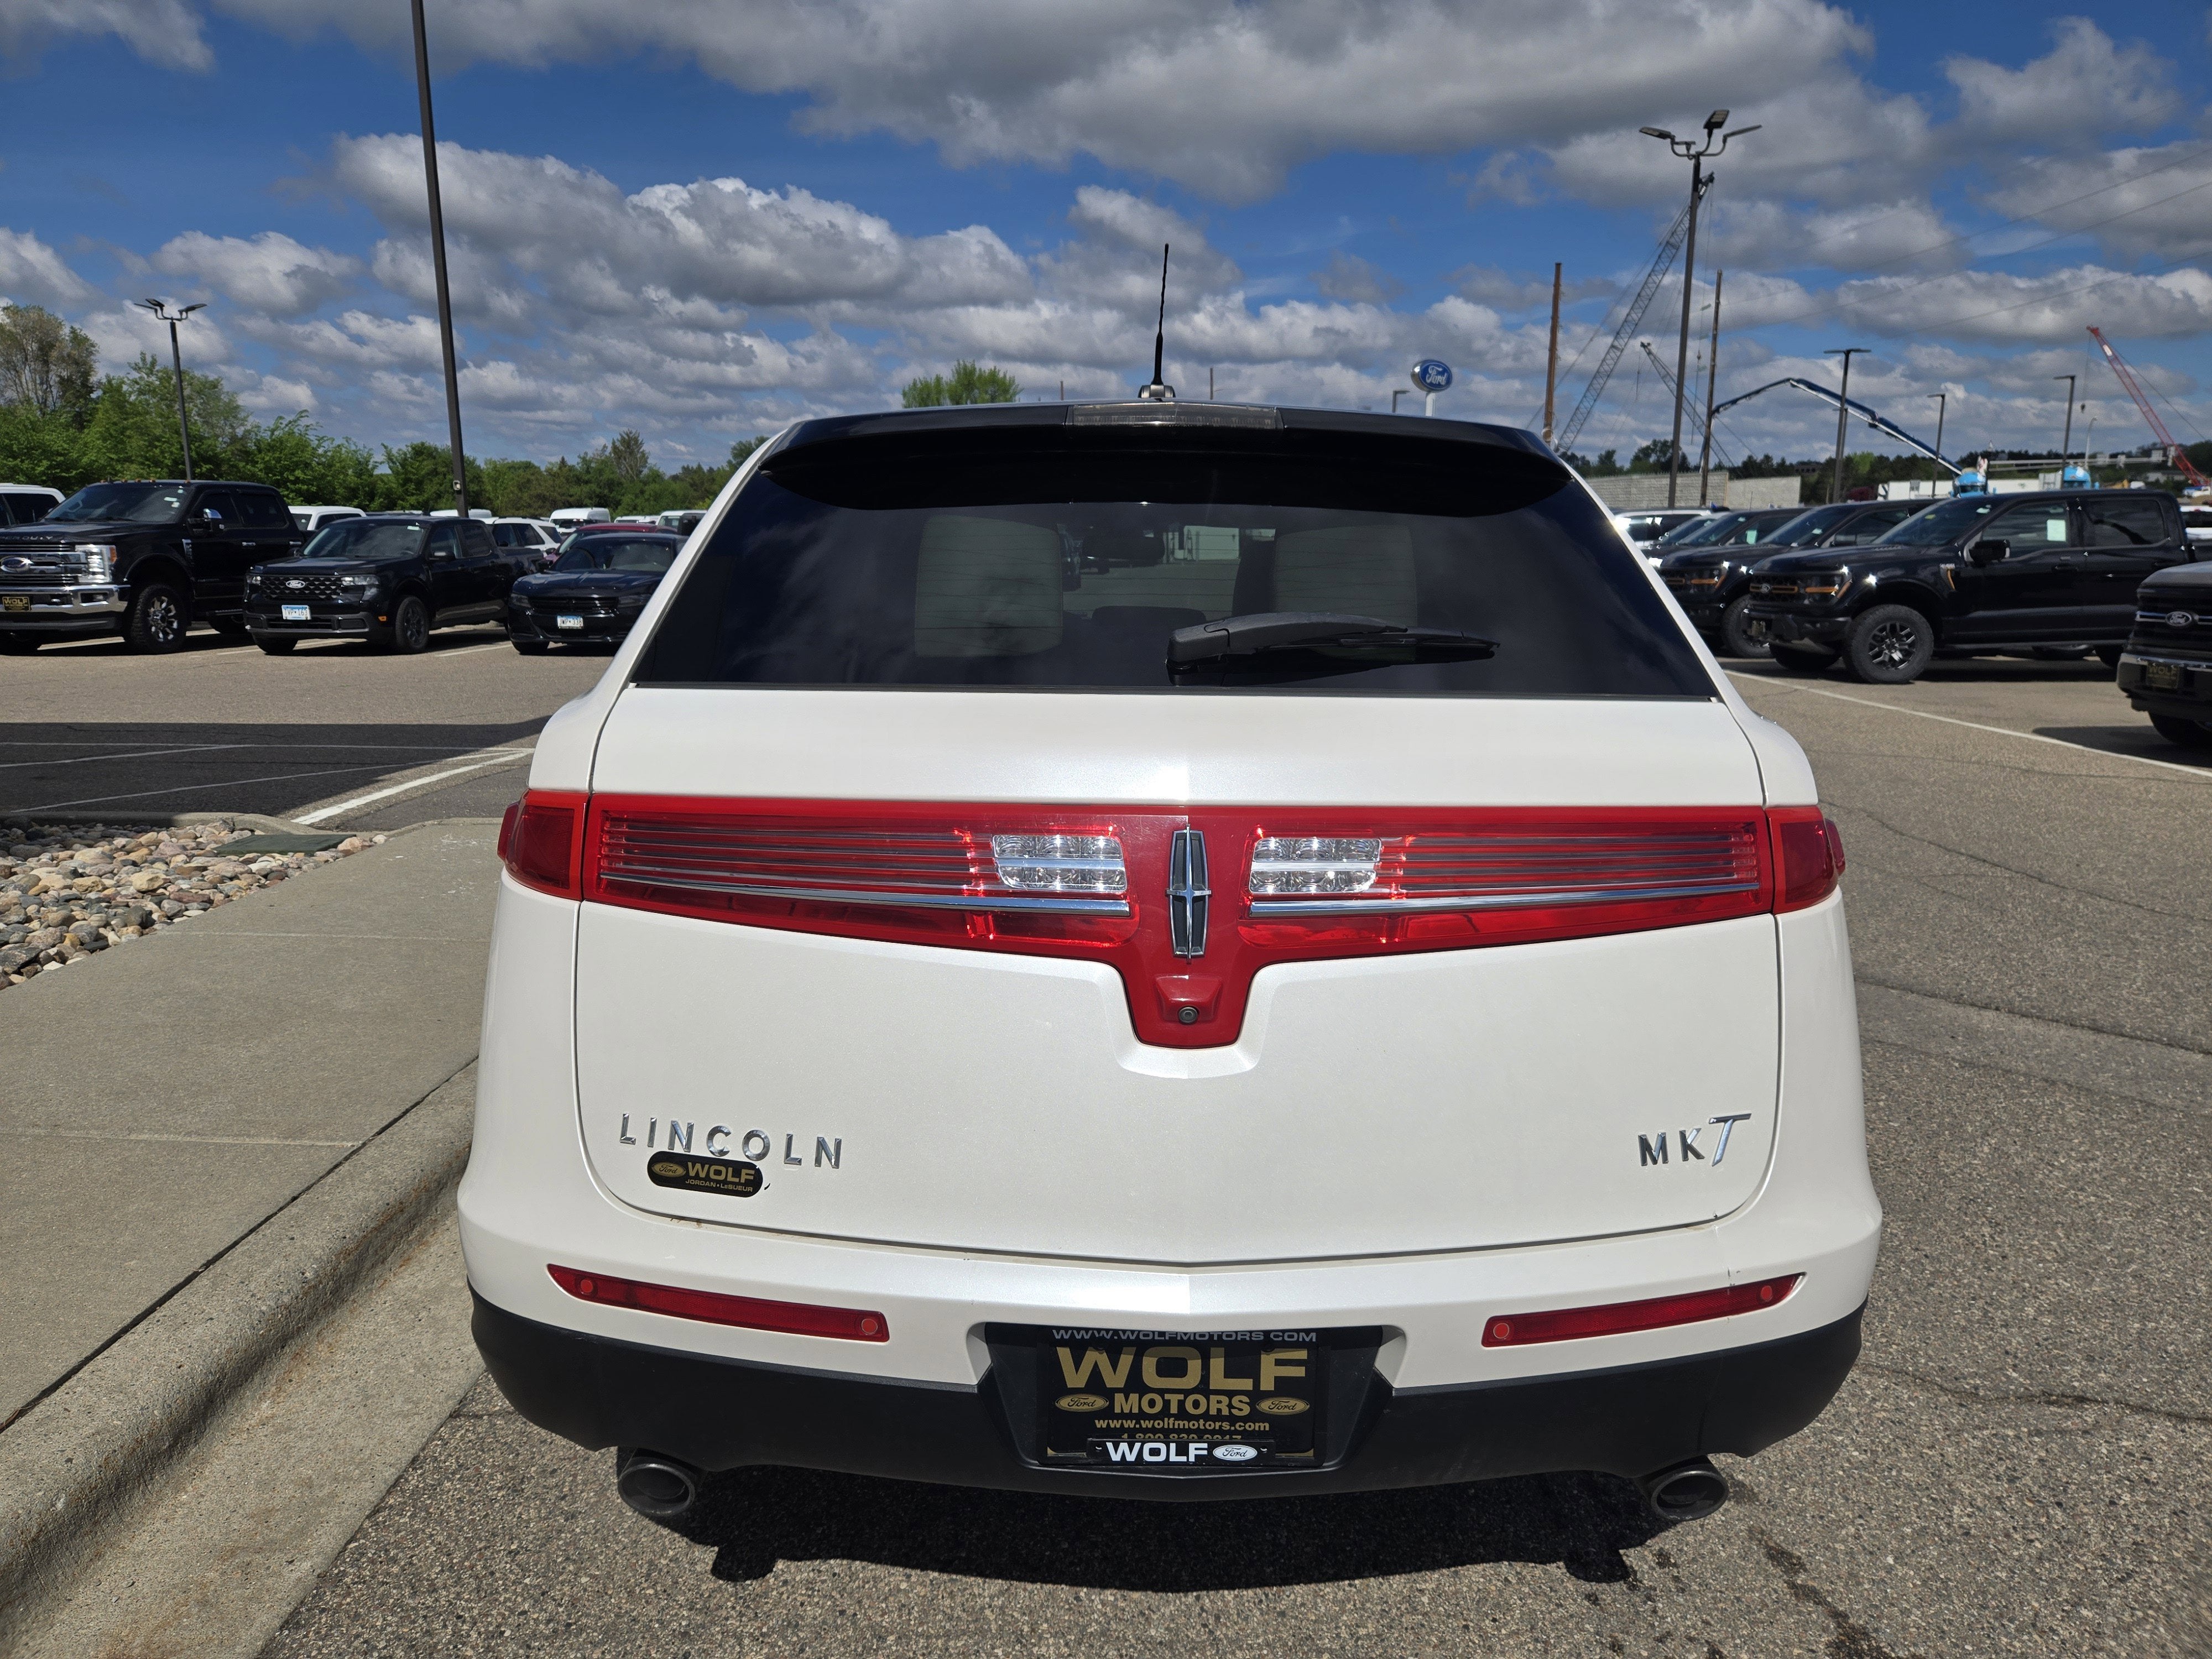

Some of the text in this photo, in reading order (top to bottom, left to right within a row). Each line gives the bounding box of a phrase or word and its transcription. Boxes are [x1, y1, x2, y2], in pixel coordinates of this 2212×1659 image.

[1426, 366, 1447, 385] Ford
[2148, 665, 2178, 675] WOLF
[619, 1113, 842, 1168] LINCOLN
[1638, 1113, 1752, 1167] MKT
[659, 1162, 755, 1183] Ford WOLF
[685, 1179, 716, 1187] JORDAN
[1052, 1329, 1316, 1342] WWW.WOLFMOTORSCOM
[1056, 1346, 1308, 1391] WOLF
[1067, 1393, 1297, 1416] Ford MOTORS Ford
[1095, 1418, 1270, 1431] www.wolfmotors.com
[1106, 1442, 1248, 1462] WOLF Ford
